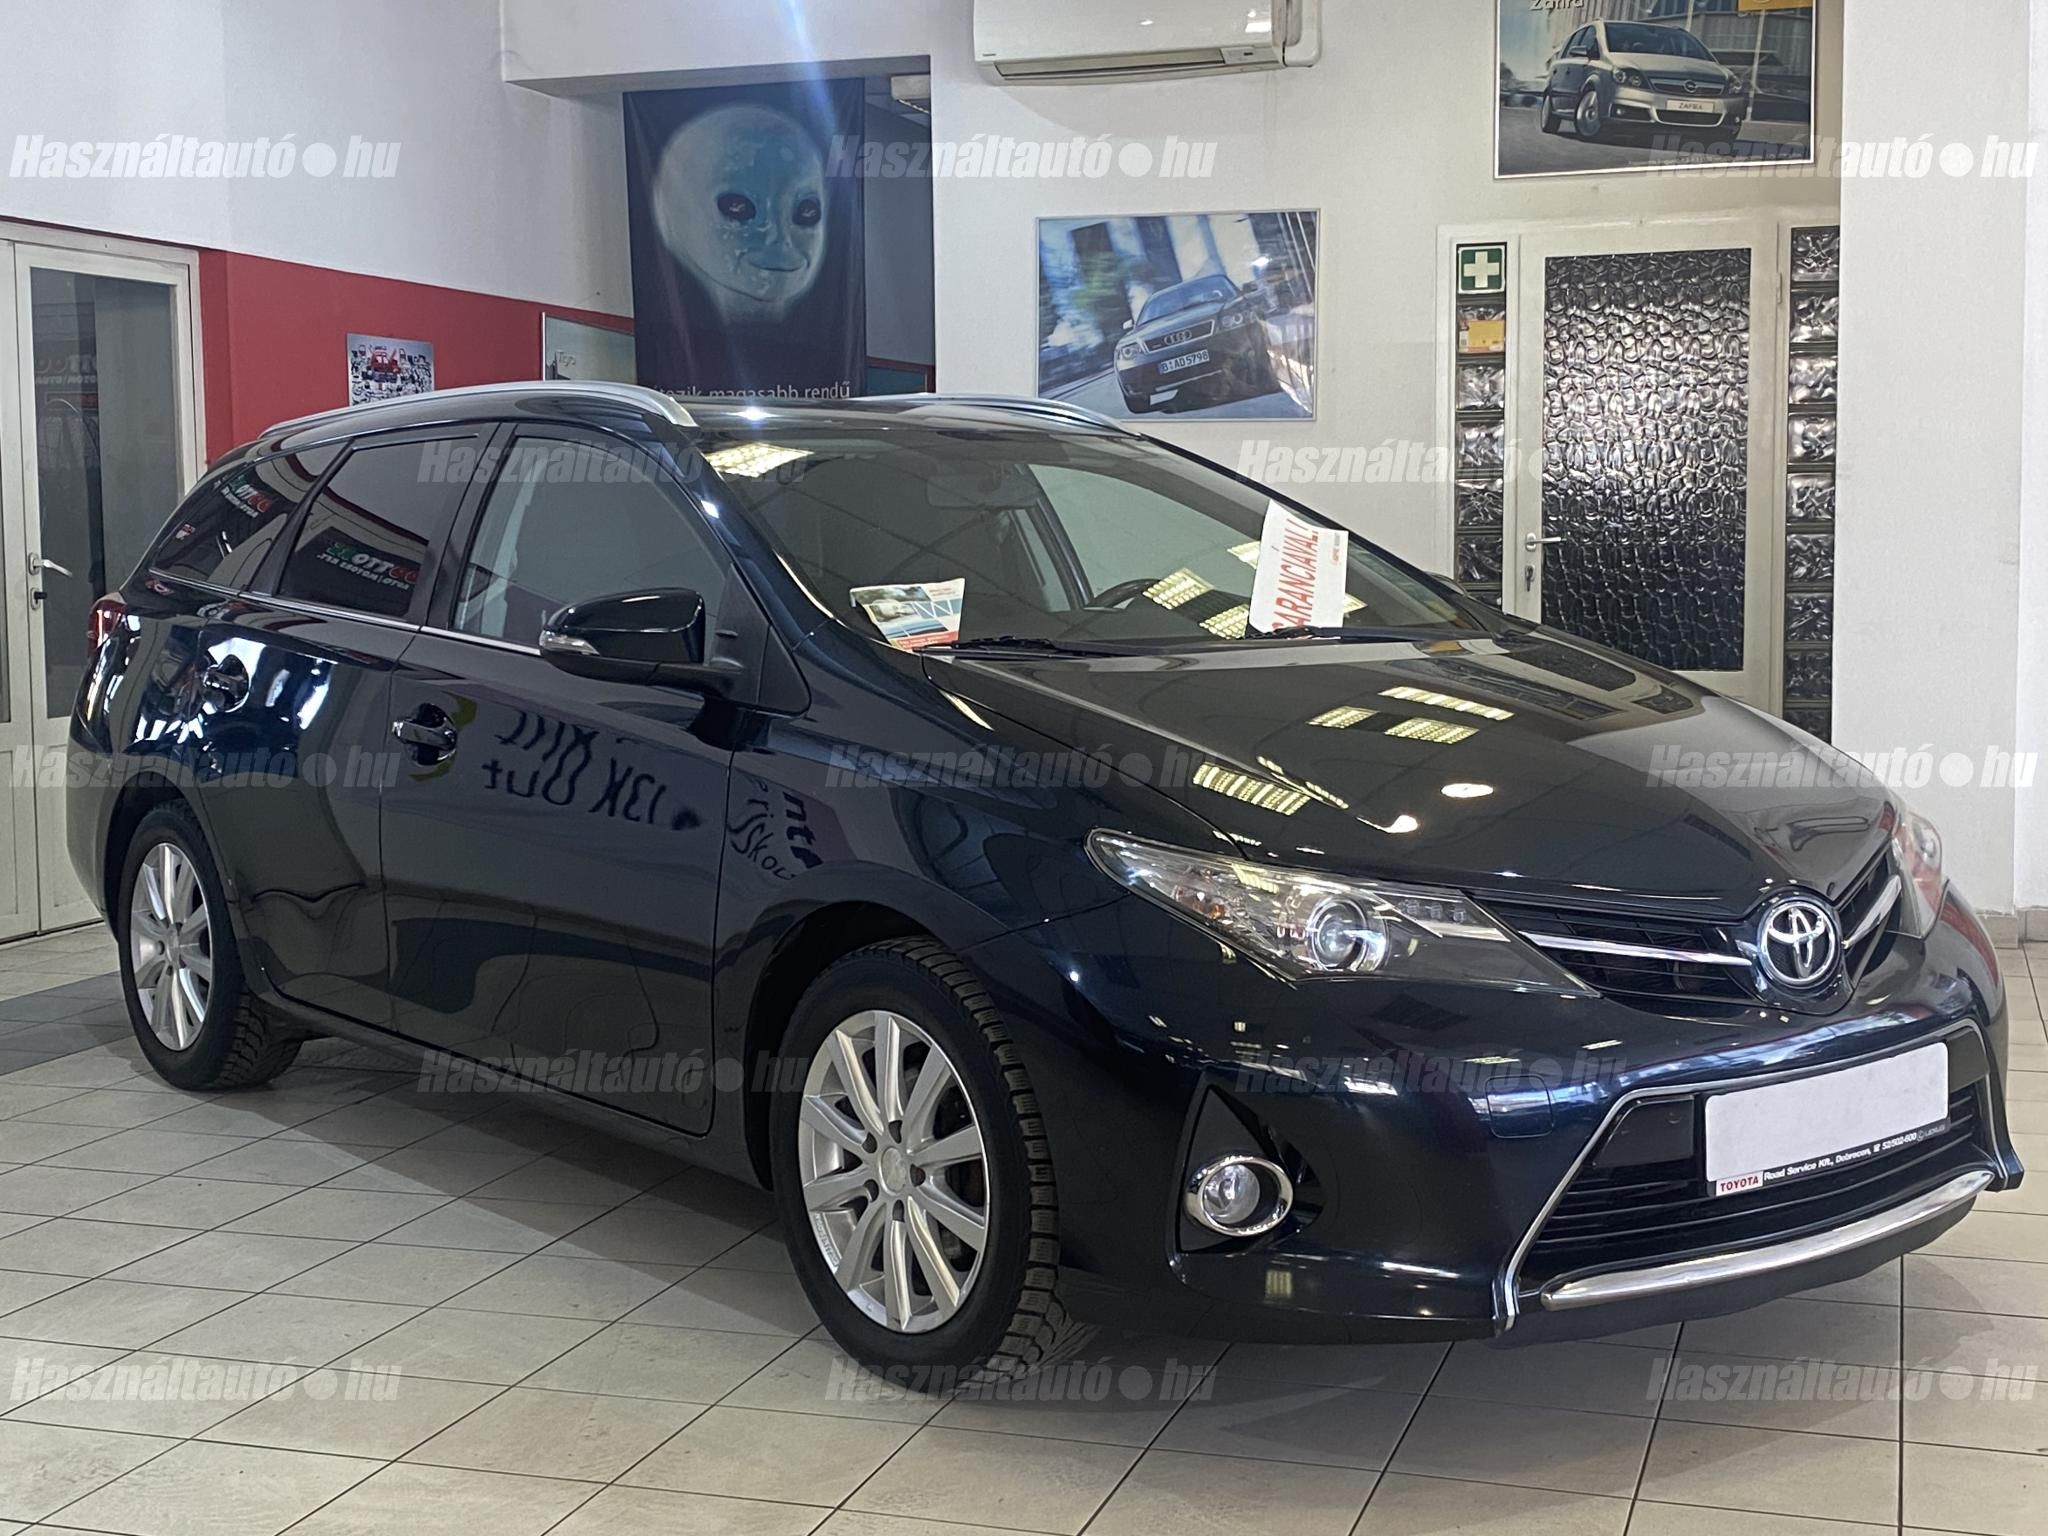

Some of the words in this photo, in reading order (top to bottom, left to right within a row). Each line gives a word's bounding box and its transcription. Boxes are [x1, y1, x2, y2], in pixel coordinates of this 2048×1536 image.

[805, 381, 850, 399] rendű
[1271, 518, 1319, 630] ARANCIÁVAL!
[1720, 1176, 1759, 1192] TOYOTA
[1787, 1163, 1817, 1176] Service
